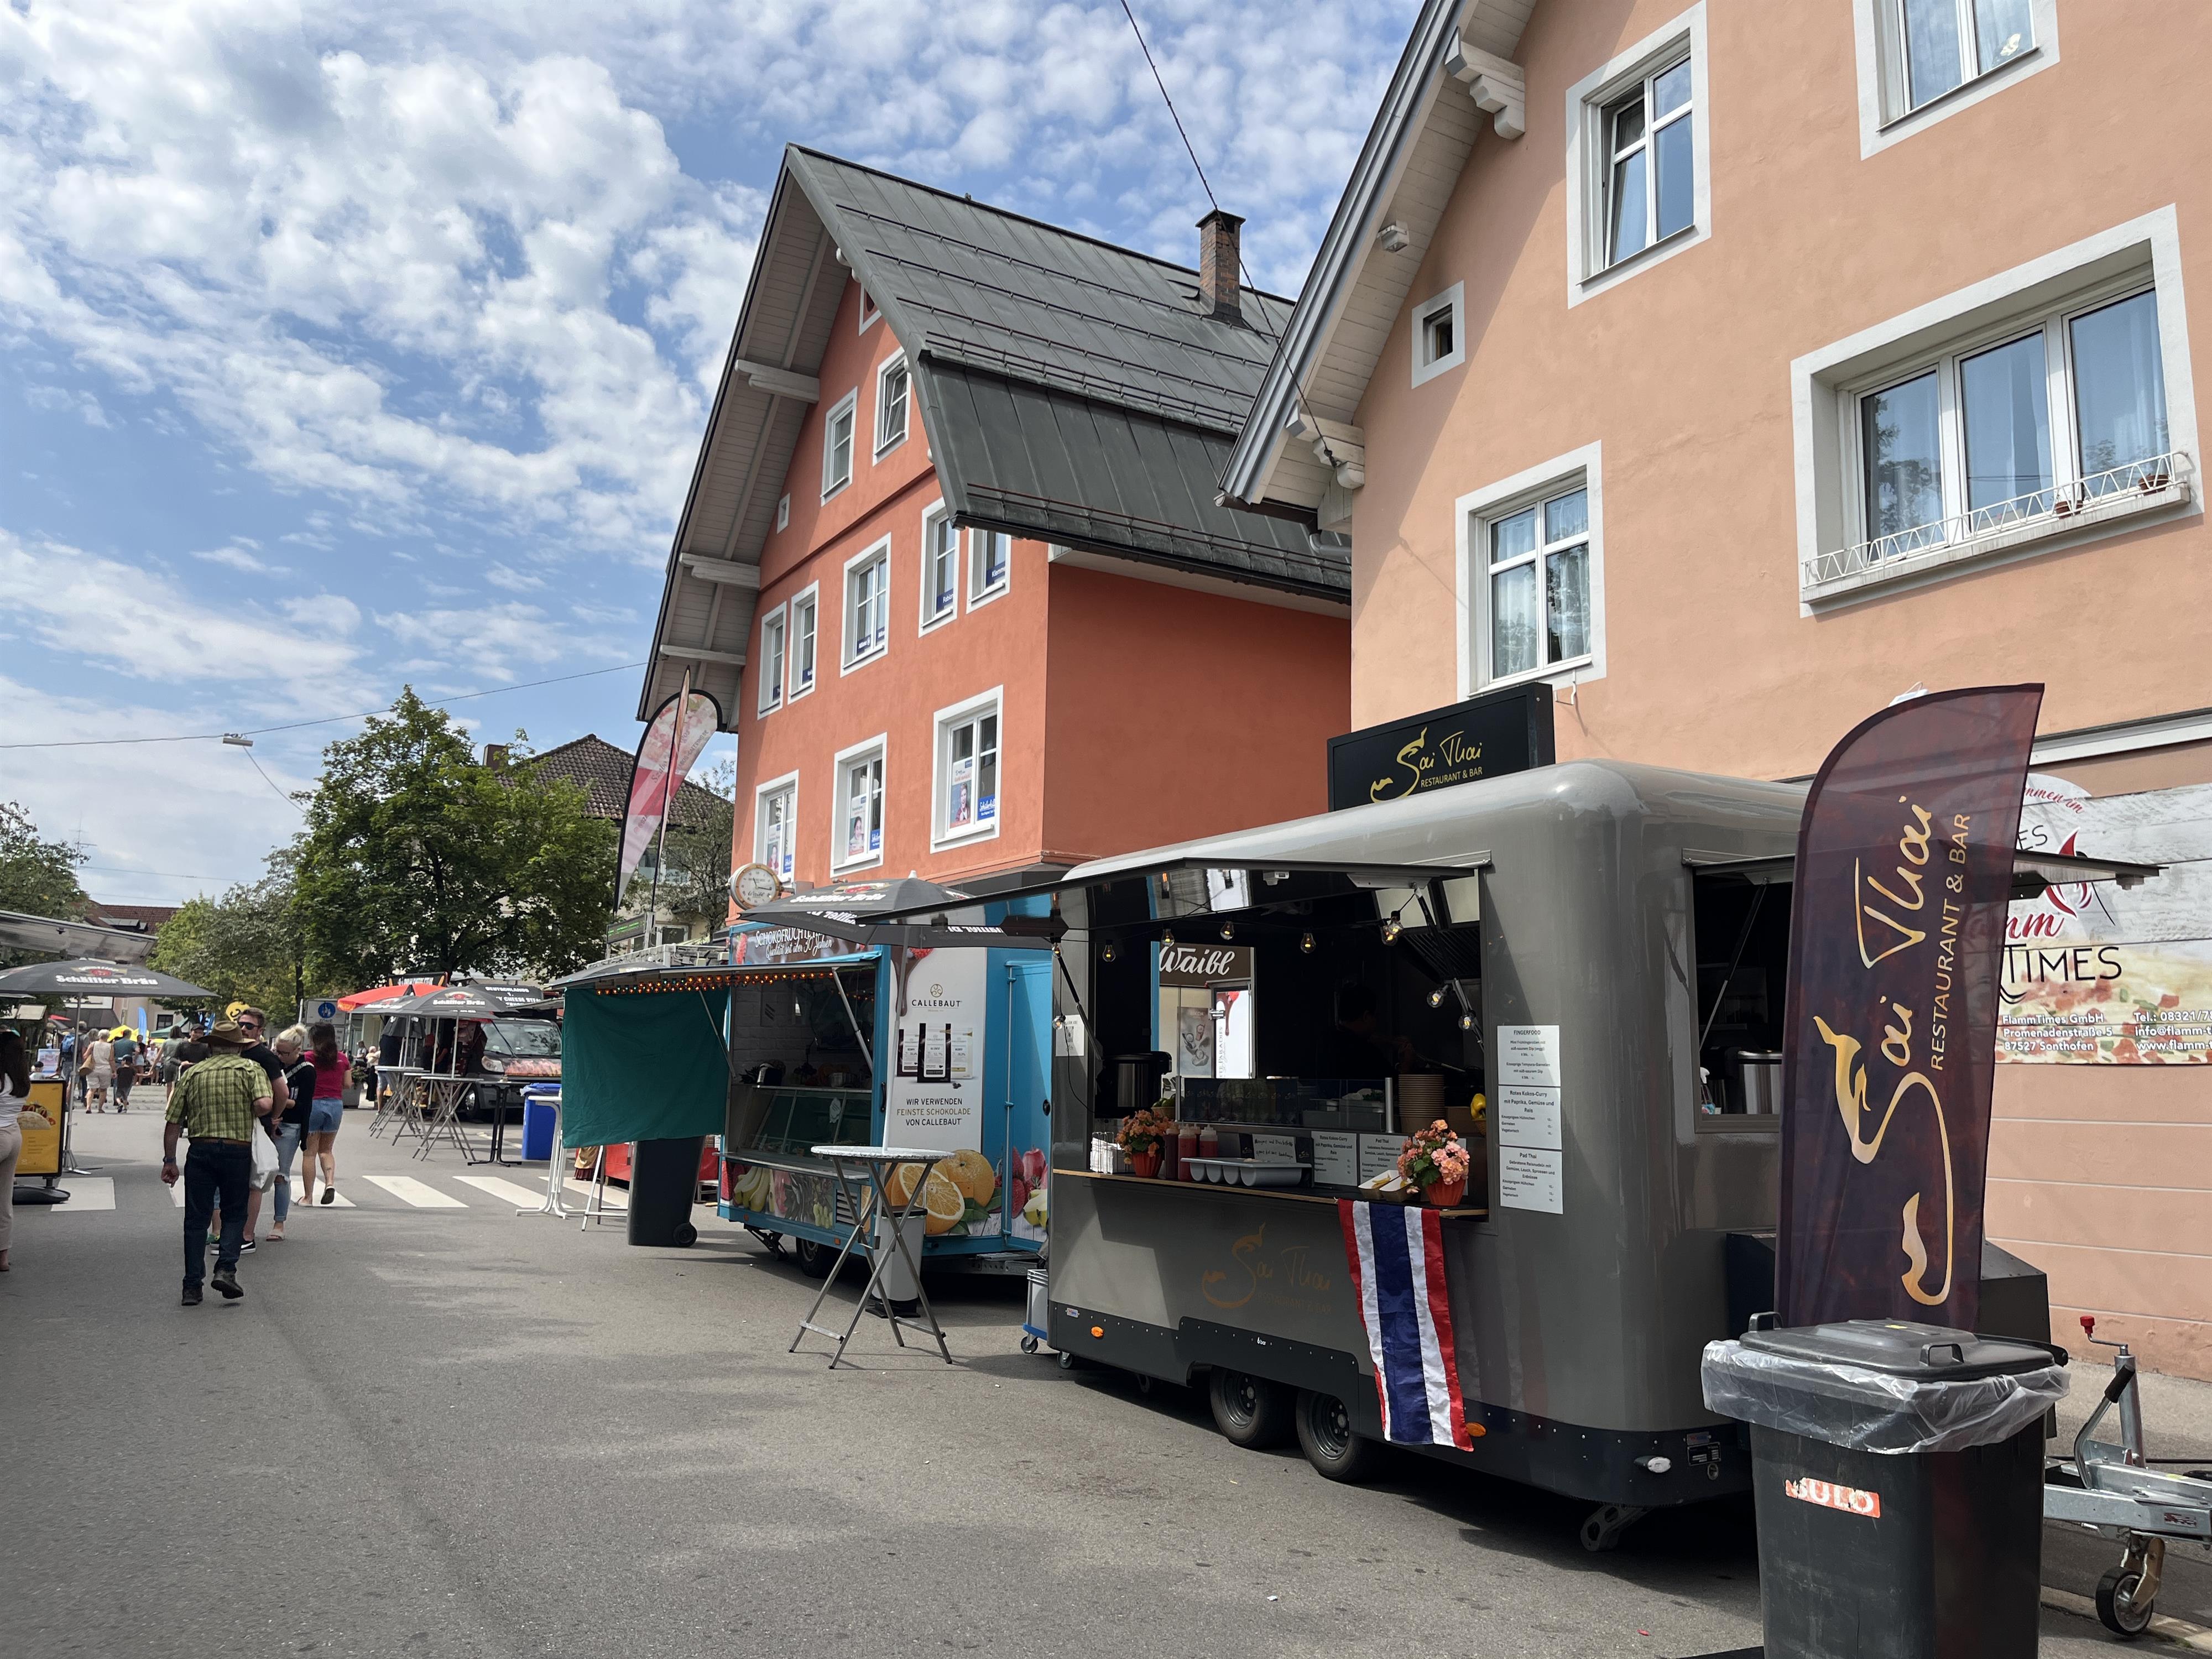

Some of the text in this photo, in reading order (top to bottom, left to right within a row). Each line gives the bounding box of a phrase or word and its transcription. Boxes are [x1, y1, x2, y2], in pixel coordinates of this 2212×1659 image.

[1439, 731, 1482, 767] Thai
[1421, 766, 1483, 788] RESTAURANT & BAR
[1854, 796, 1931, 969] Thai
[804, 937, 813, 953] 30
[1931, 813, 1970, 1071] RESTAURANT & BAR
[2005, 943, 2122, 984] TIMES
[2002, 1013, 2104, 1024] FlammTimes GmbH
[2133, 1011, 2157, 1021] Tel.:
[2004, 1026, 2113, 1037] Promenadenstraße 5
[2005, 1040, 2094, 1051] 87527 Sonthofen
